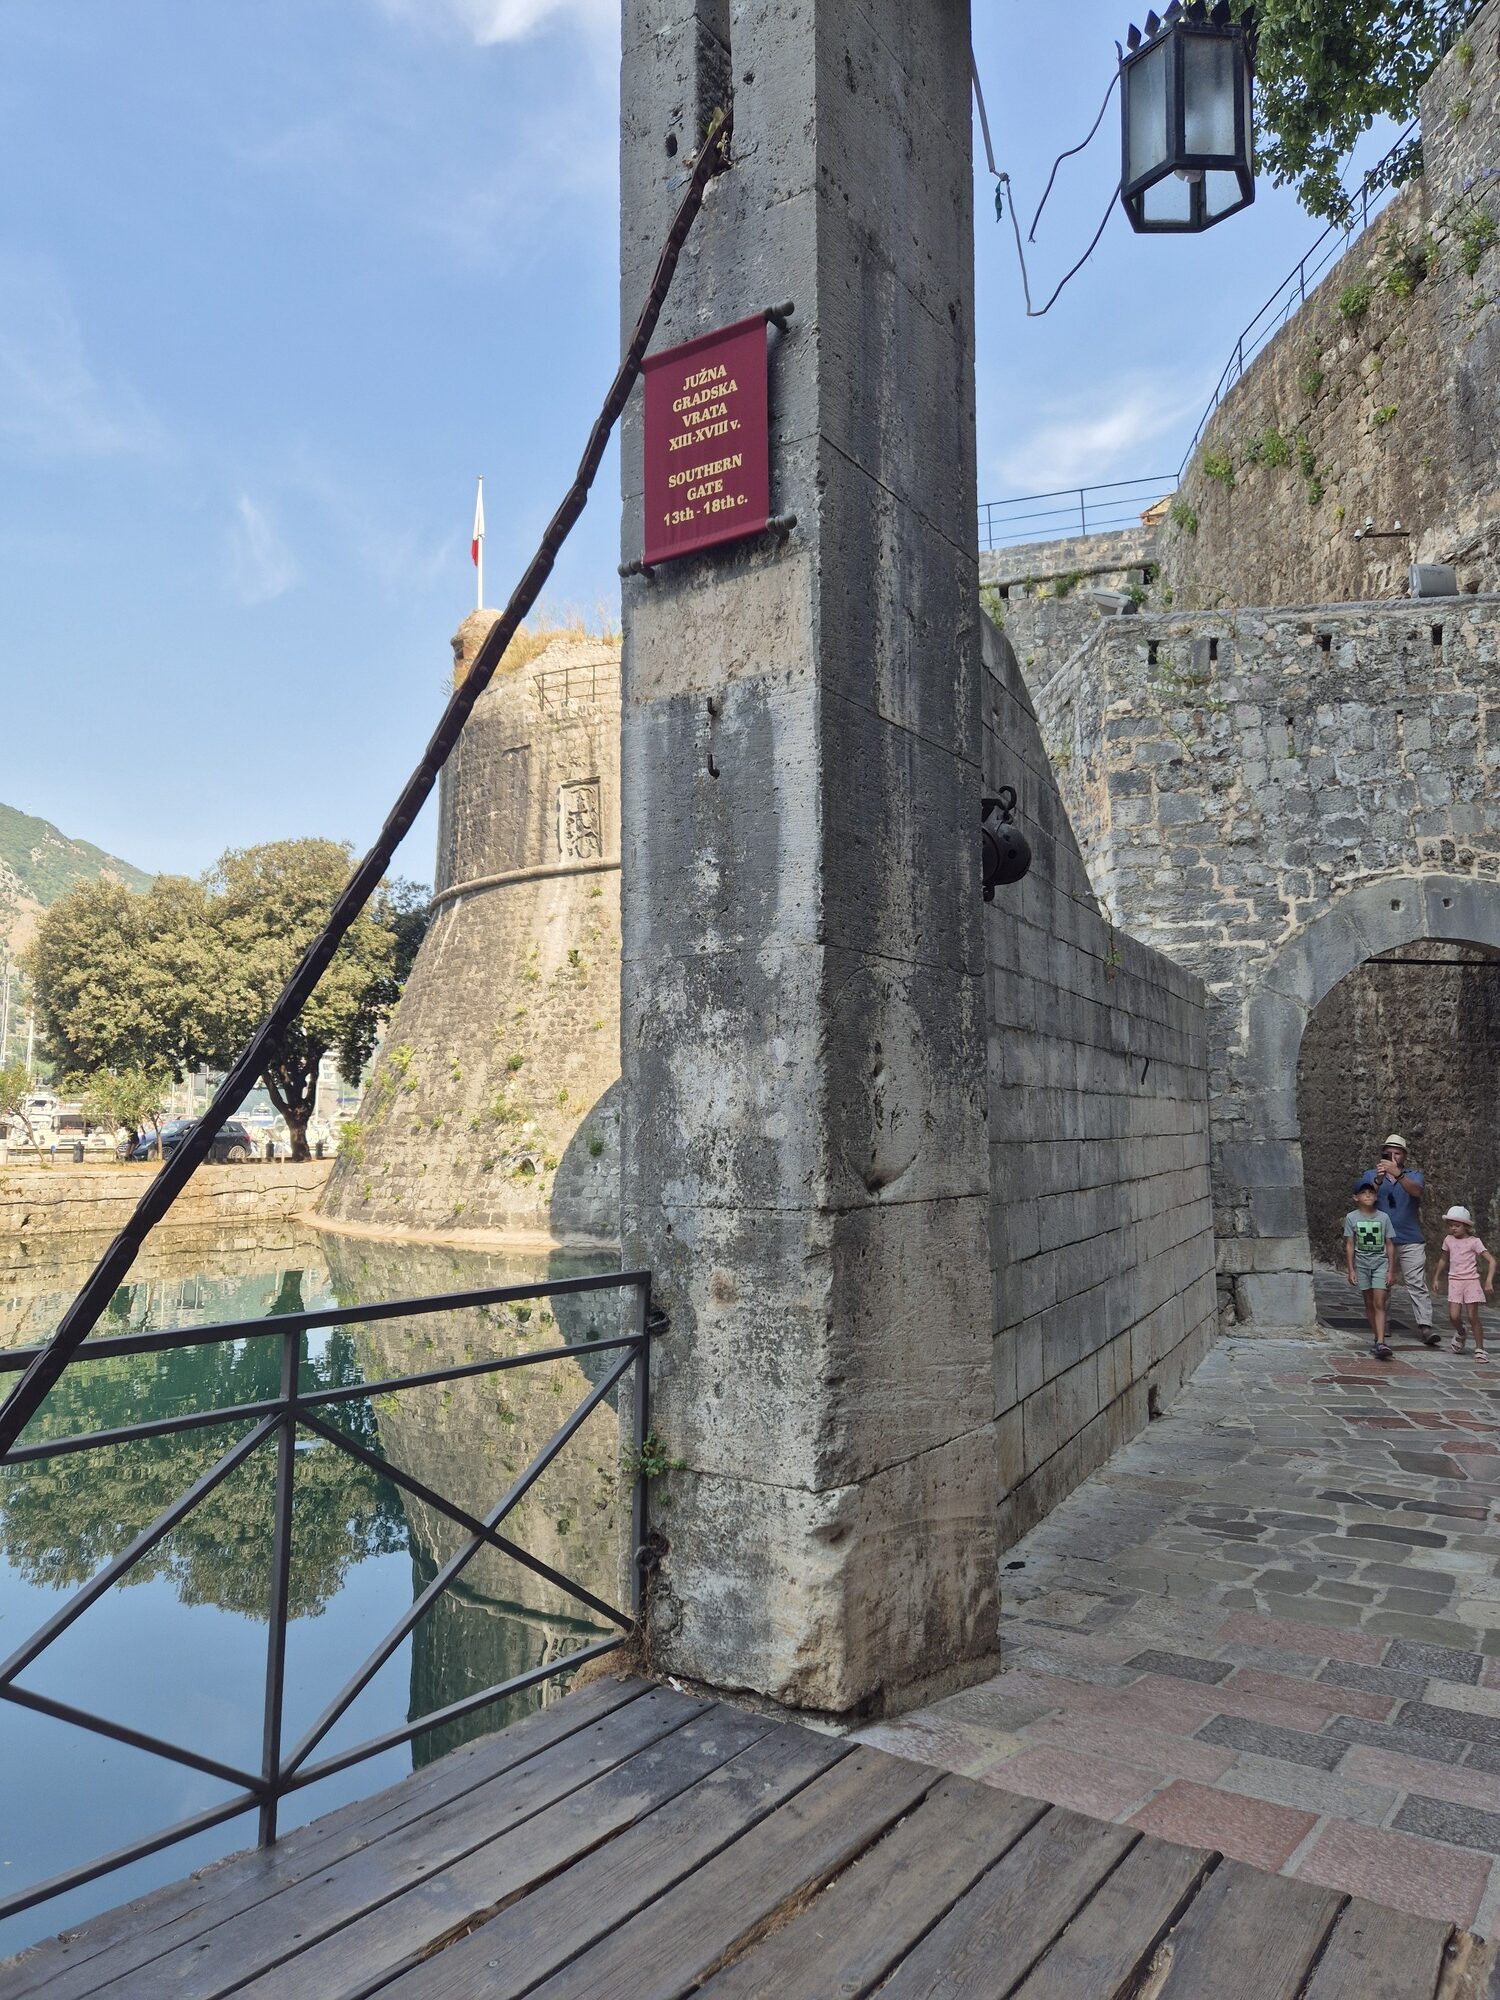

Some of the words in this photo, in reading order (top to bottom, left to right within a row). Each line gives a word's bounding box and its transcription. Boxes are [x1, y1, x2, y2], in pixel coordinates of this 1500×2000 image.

[683, 364, 727, 391] JUŽNA
[672, 379, 738, 413] GRADSKA
[682, 402, 728, 428] VRATA
[668, 420, 729, 451] XIII-XVIII
[730, 419, 741, 431] v.
[668, 453, 743, 488] SOUTHERN
[686, 479, 723, 501] GATE
[663, 507, 694, 526] 13th
[703, 495, 735, 515] 18th
[736, 496, 748, 506] c.
